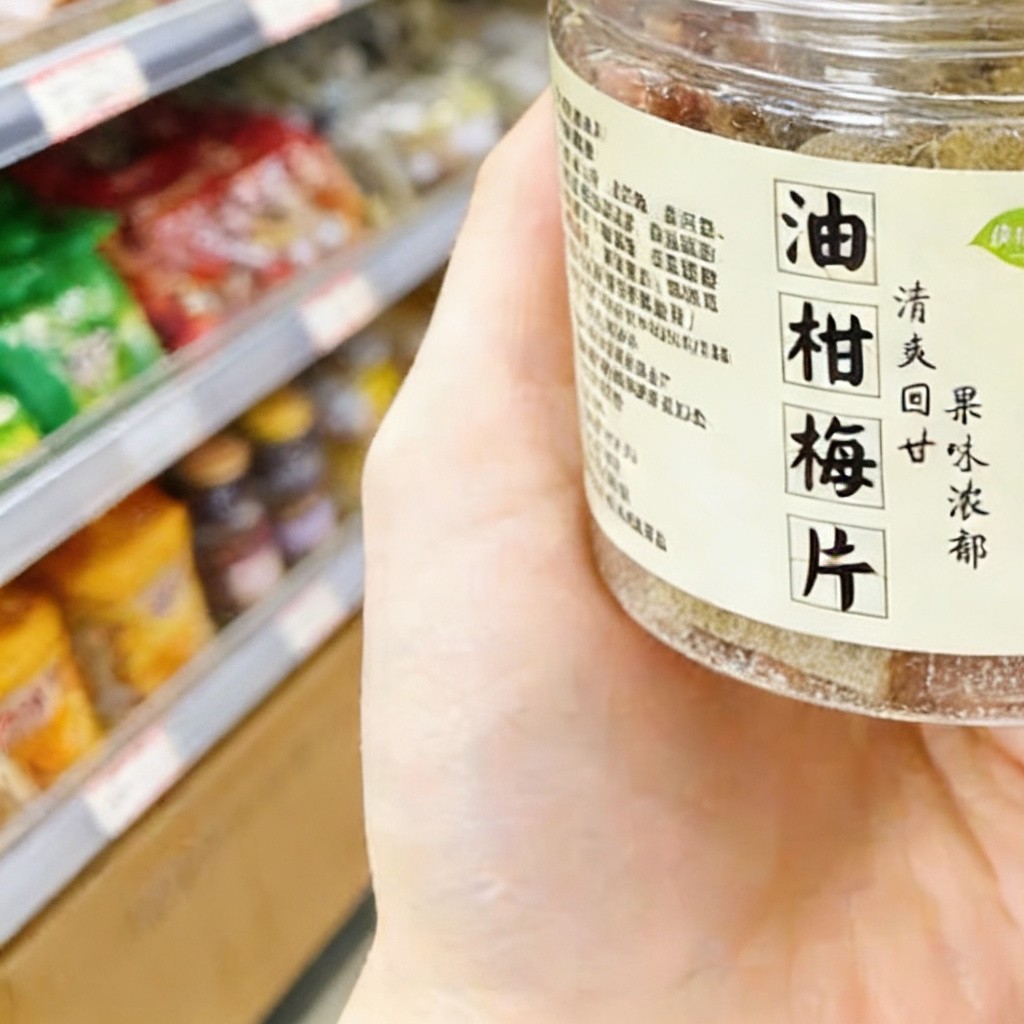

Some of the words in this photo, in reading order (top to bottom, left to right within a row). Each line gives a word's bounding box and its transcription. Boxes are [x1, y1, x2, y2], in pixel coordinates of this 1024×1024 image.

[781, 189, 877, 613] 油柑梅片
[893, 280, 936, 463] 清爽回甘
[944, 385, 990, 570] 果味浓郁
